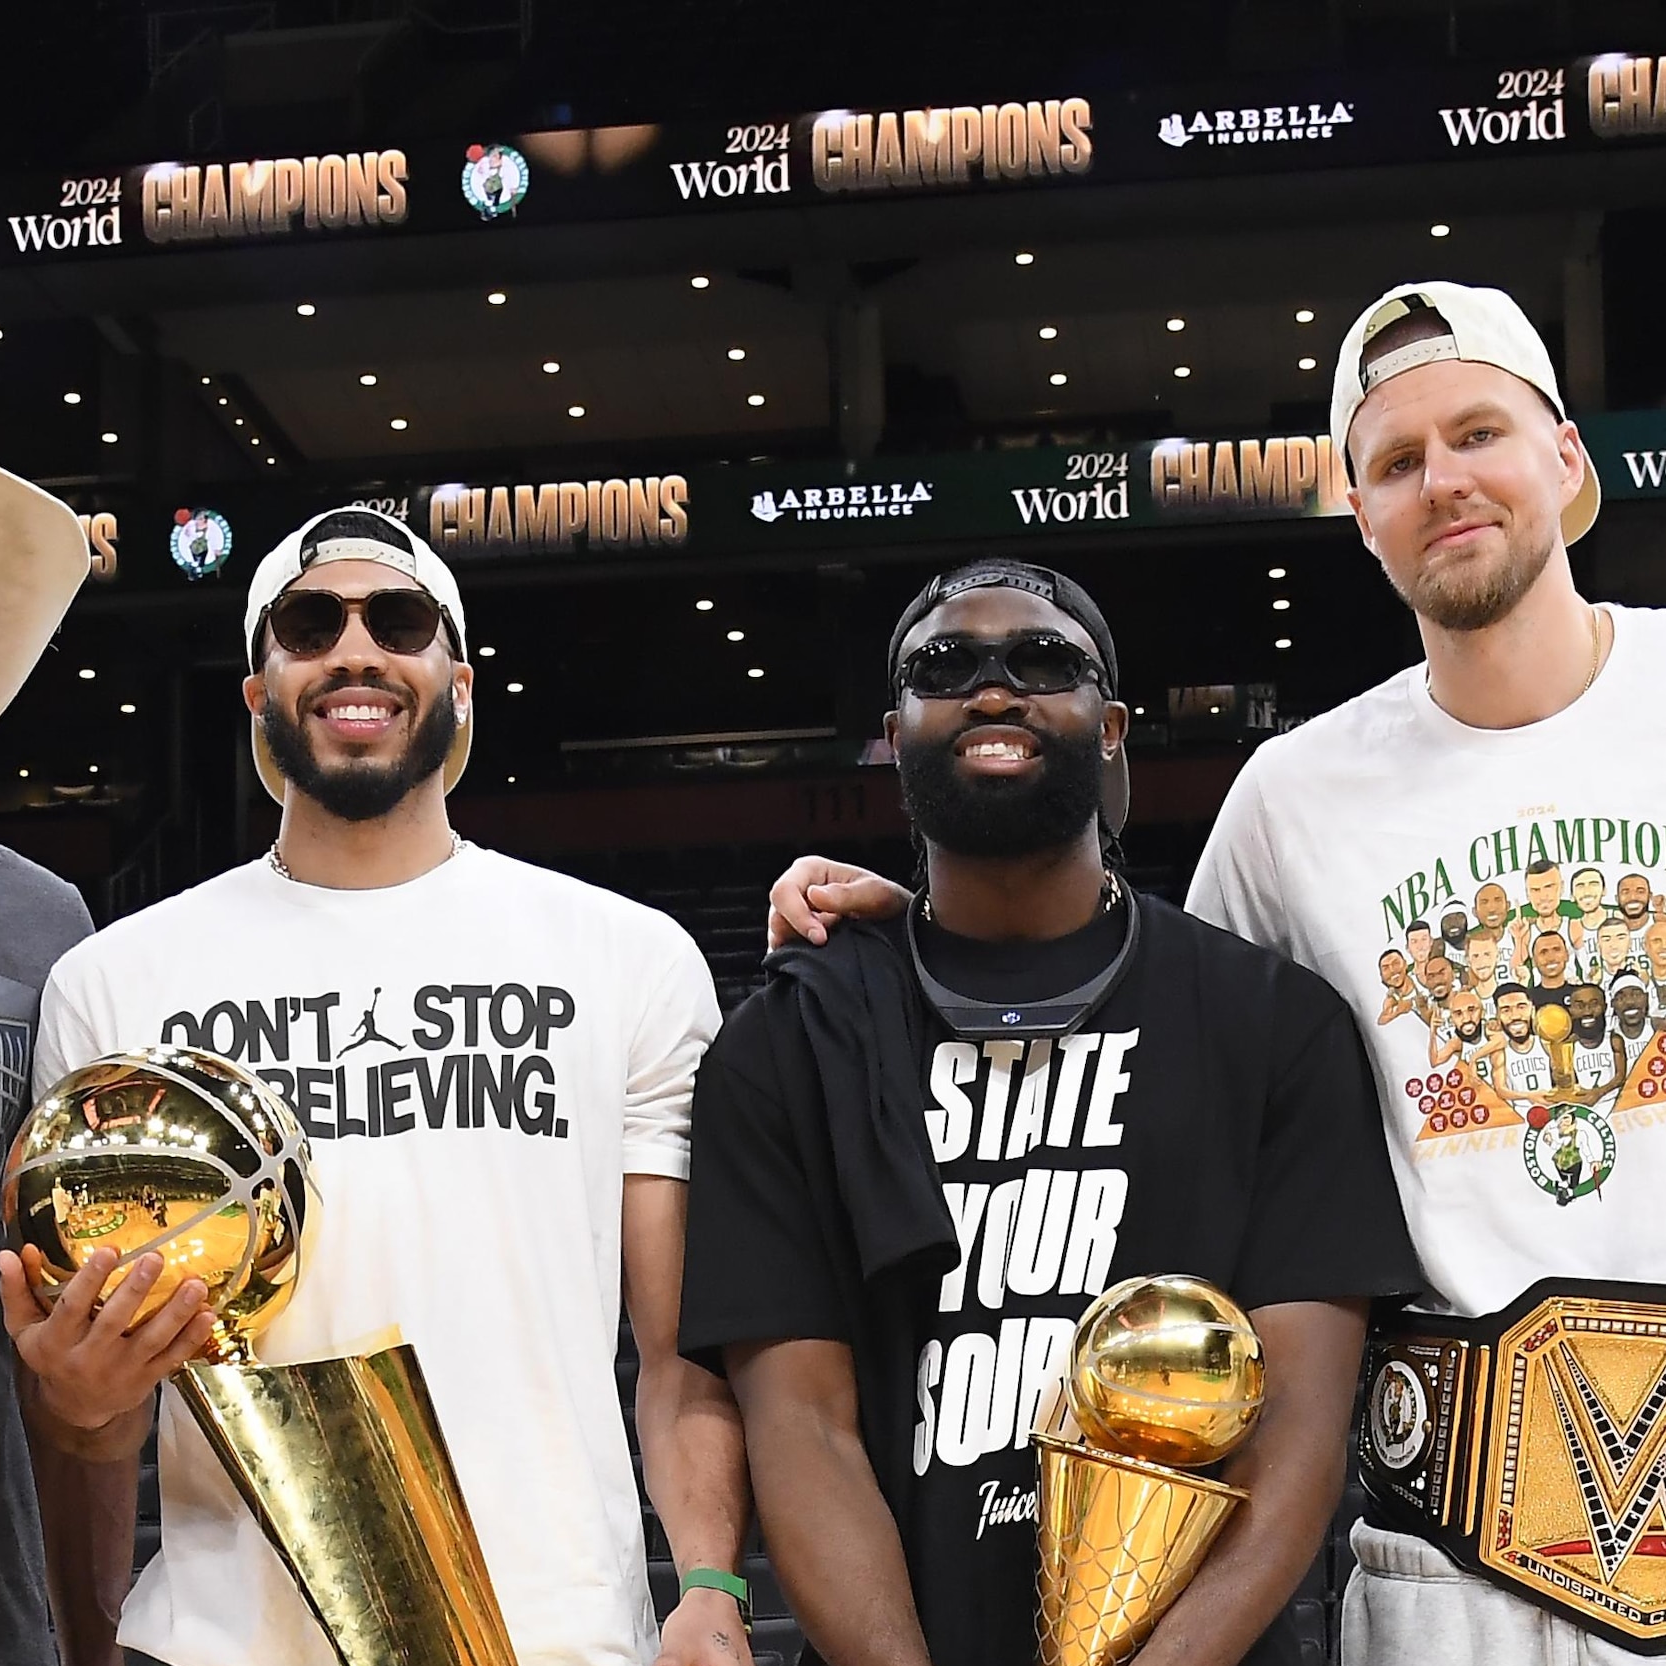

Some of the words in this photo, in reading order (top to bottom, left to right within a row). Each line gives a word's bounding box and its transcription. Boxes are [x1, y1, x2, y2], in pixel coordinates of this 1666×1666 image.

[1497, 69, 1566, 99] 2024
[726, 125, 790, 153] 2024
[1188, 104, 1353, 134] ARBELLA
[1207, 125, 1335, 145] INSURANCE
[1438, 100, 1566, 147] World
[810, 97, 1093, 192] CHAMPIONS
[61, 177, 123, 207] 2024
[142, 149, 409, 244] CHAMPIONS
[670, 156, 790, 200] World
[9, 208, 123, 253] World
[1067, 454, 1130, 481] 2024
[1150, 436, 1343, 514] CHAMPI
[351, 497, 410, 521] 024
[429, 474, 689, 555] CHAMPIONS
[777, 483, 931, 509] ARBELLA
[796, 502, 914, 522] INSURANCE
[1013, 483, 1130, 525] World
[1379, 856, 1454, 943] NBA
[160, 993, 339, 1064] DON'T
[412, 985, 576, 1050] STOP
[1511, 1056, 1547, 1077] CELTICS
[1576, 1052, 1611, 1073] CELTICS
[1589, 1071, 1602, 1088] 7
[924, 1027, 1140, 1163] STATE
[1523, 1129, 1548, 1187] BOSTON
[1587, 1112, 1615, 1169] CELTICS
[938, 1168, 1129, 1312] YOUR
[913, 1317, 1078, 1476] SOUR
[1526, 1559, 1642, 1623] UNDISPUTED
